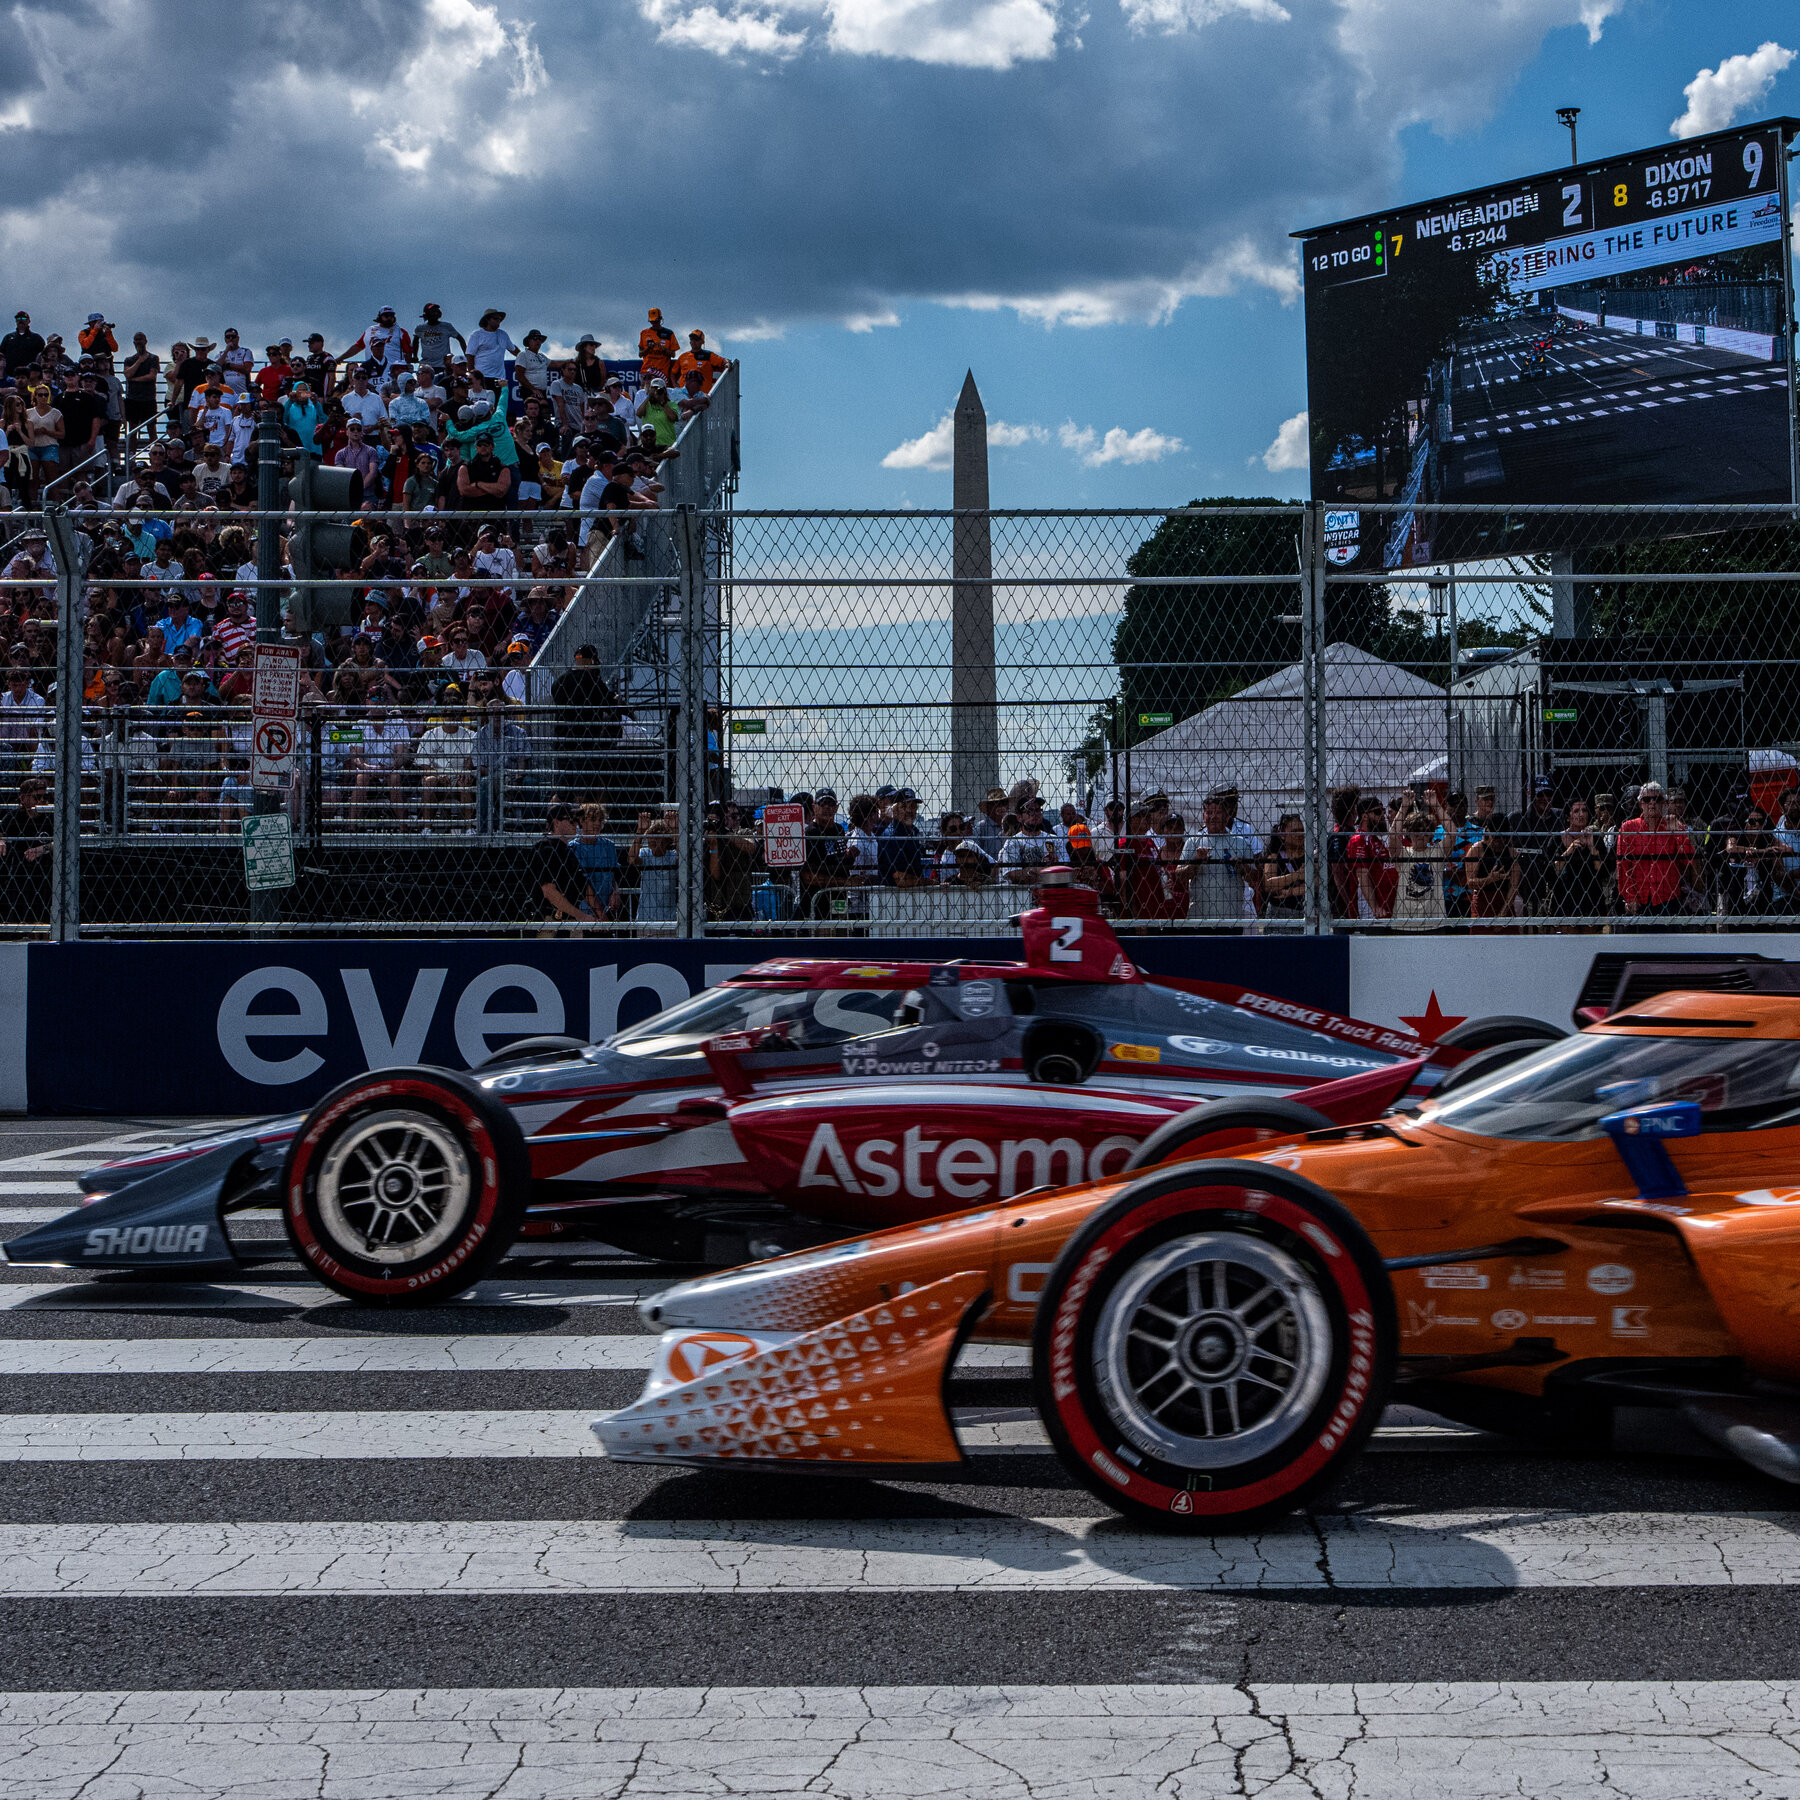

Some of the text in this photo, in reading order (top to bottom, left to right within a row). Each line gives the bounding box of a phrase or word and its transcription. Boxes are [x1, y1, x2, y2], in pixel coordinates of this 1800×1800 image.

[1645, 153, 1713, 189] DIXON
[1742, 141, 1764, 189] 9
[1561, 183, 1582, 227] 2
[1613, 183, 1628, 207] 8
[1645, 179, 1712, 209] -6.9717
[1416, 192, 1539, 239] NEWGARDEN
[1391, 234, 1404, 257] 7
[1446, 224, 1508, 252] -6.7244
[1604, 224, 1645, 256] THE
[1652, 209, 1738, 243] FUTURE
[1310, 244, 1371, 272] 12 TO GO
[1324, 529, 1360, 542] INDYCAR
[767, 808, 800, 816] EMERGENCY
[776, 838, 792, 848] NOT
[778, 826, 791, 836] DO
[771, 849, 800, 860] BLOCK
[1050, 916, 1084, 962] 2
[1236, 991, 1325, 1026] PENSKE
[1324, 1015, 1377, 1041] Truck
[1375, 1031, 1440, 1058] Rental
[841, 1043, 878, 1056] Shell
[1243, 1045, 1396, 1069] Gallaghe
[841, 1058, 934, 1074] V-Power
[83, 1223, 209, 1257] SHOWA
[407, 1221, 486, 1288] Firestone
[1319, 1307, 1375, 1451] Firestone
